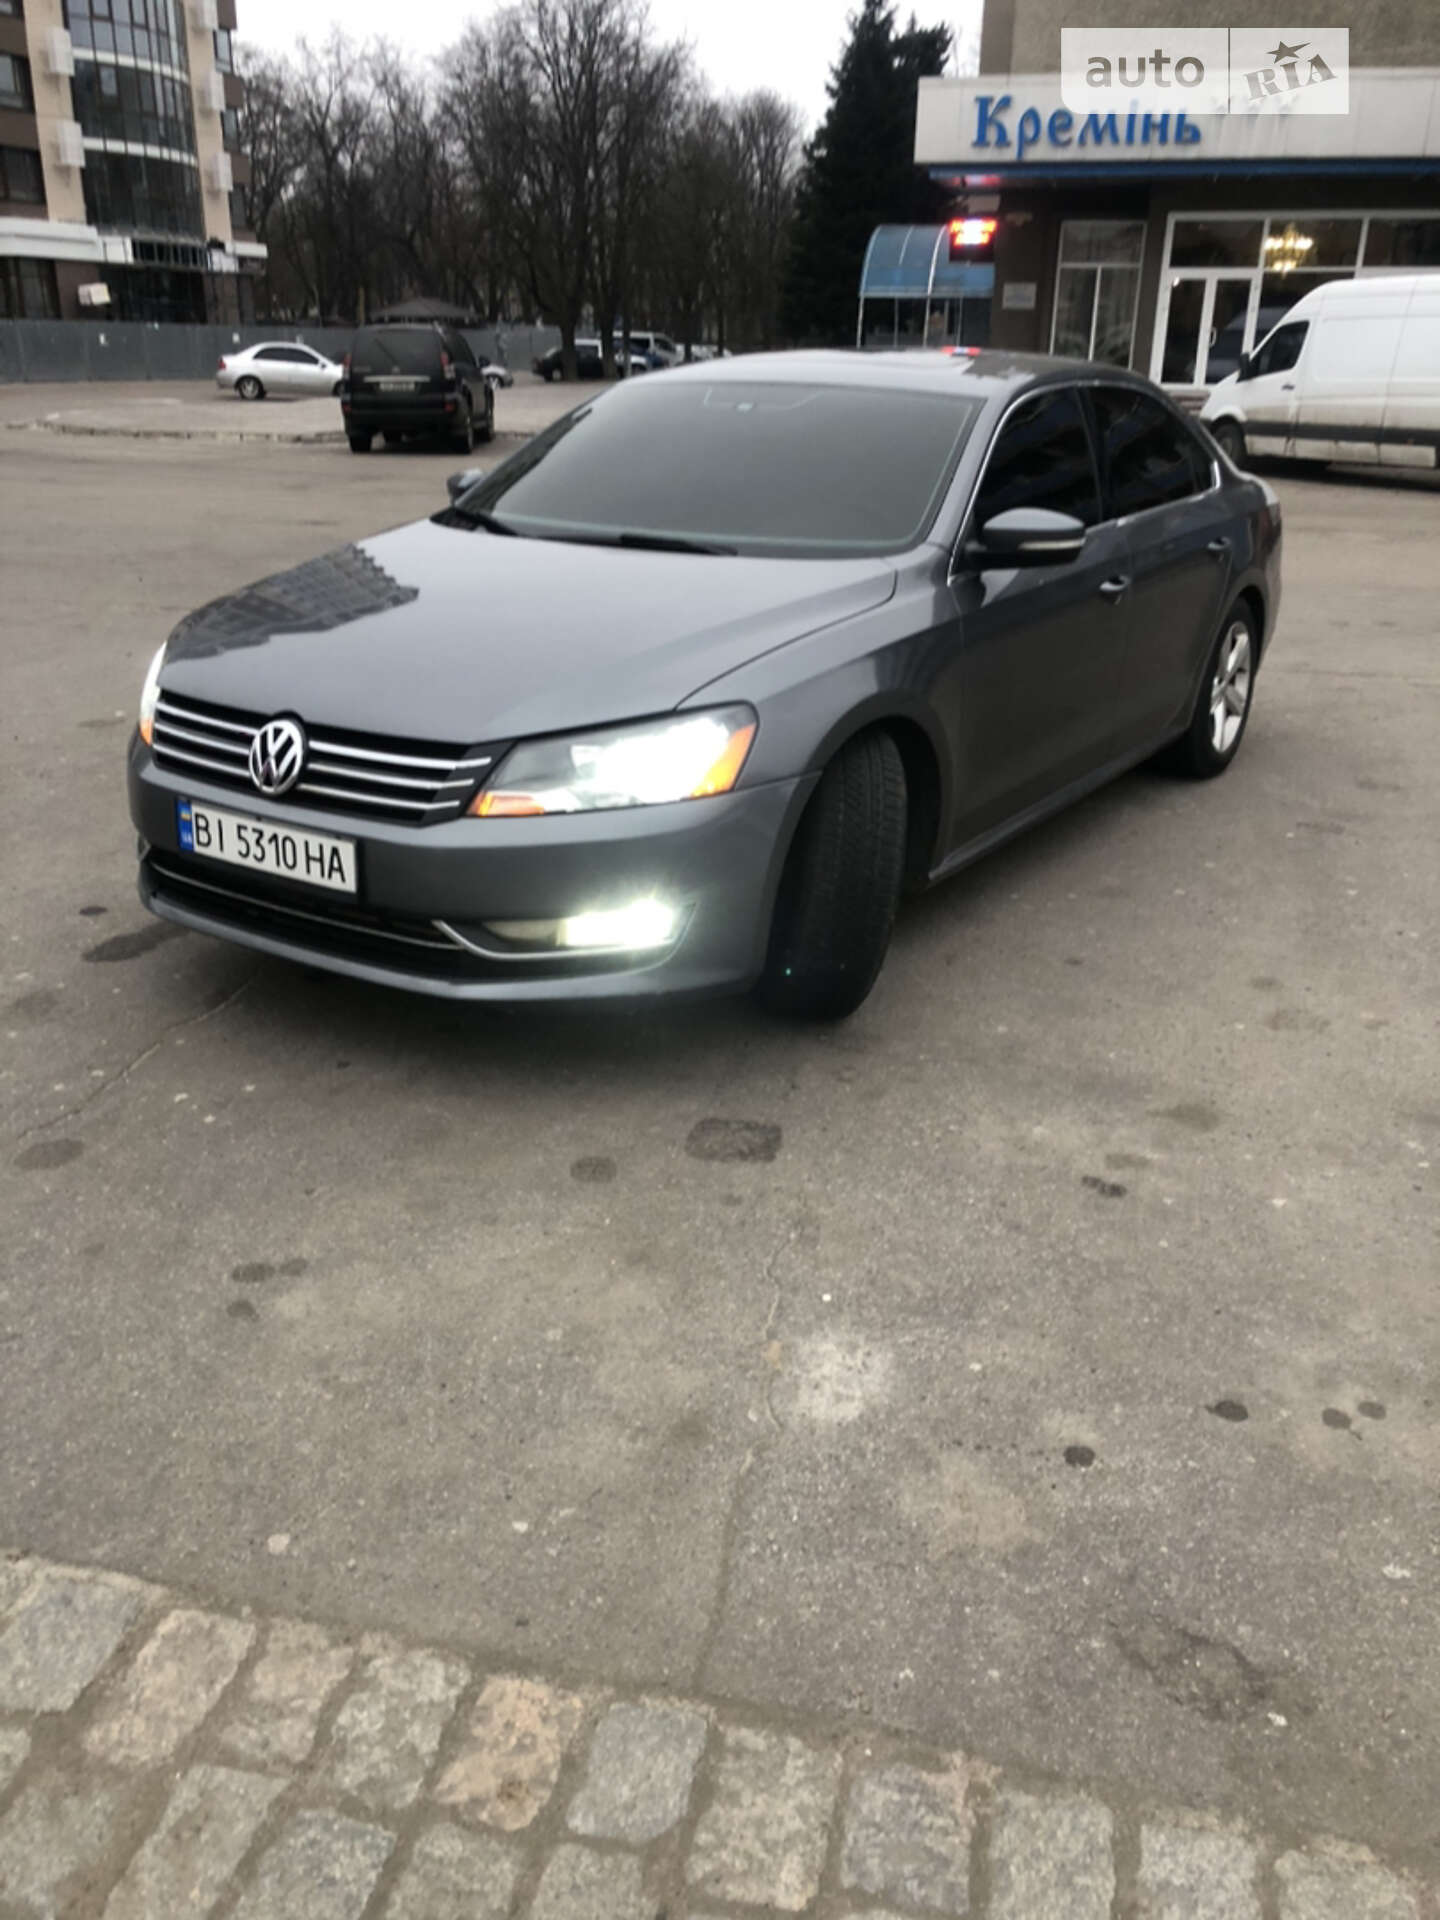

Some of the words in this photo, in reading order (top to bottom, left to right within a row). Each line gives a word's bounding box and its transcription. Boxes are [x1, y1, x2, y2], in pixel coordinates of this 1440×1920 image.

[972, 95, 1204, 160] Кремінь
[194, 812, 224, 853] BI
[236, 824, 298, 870] 5310
[304, 839, 346, 883] HA
